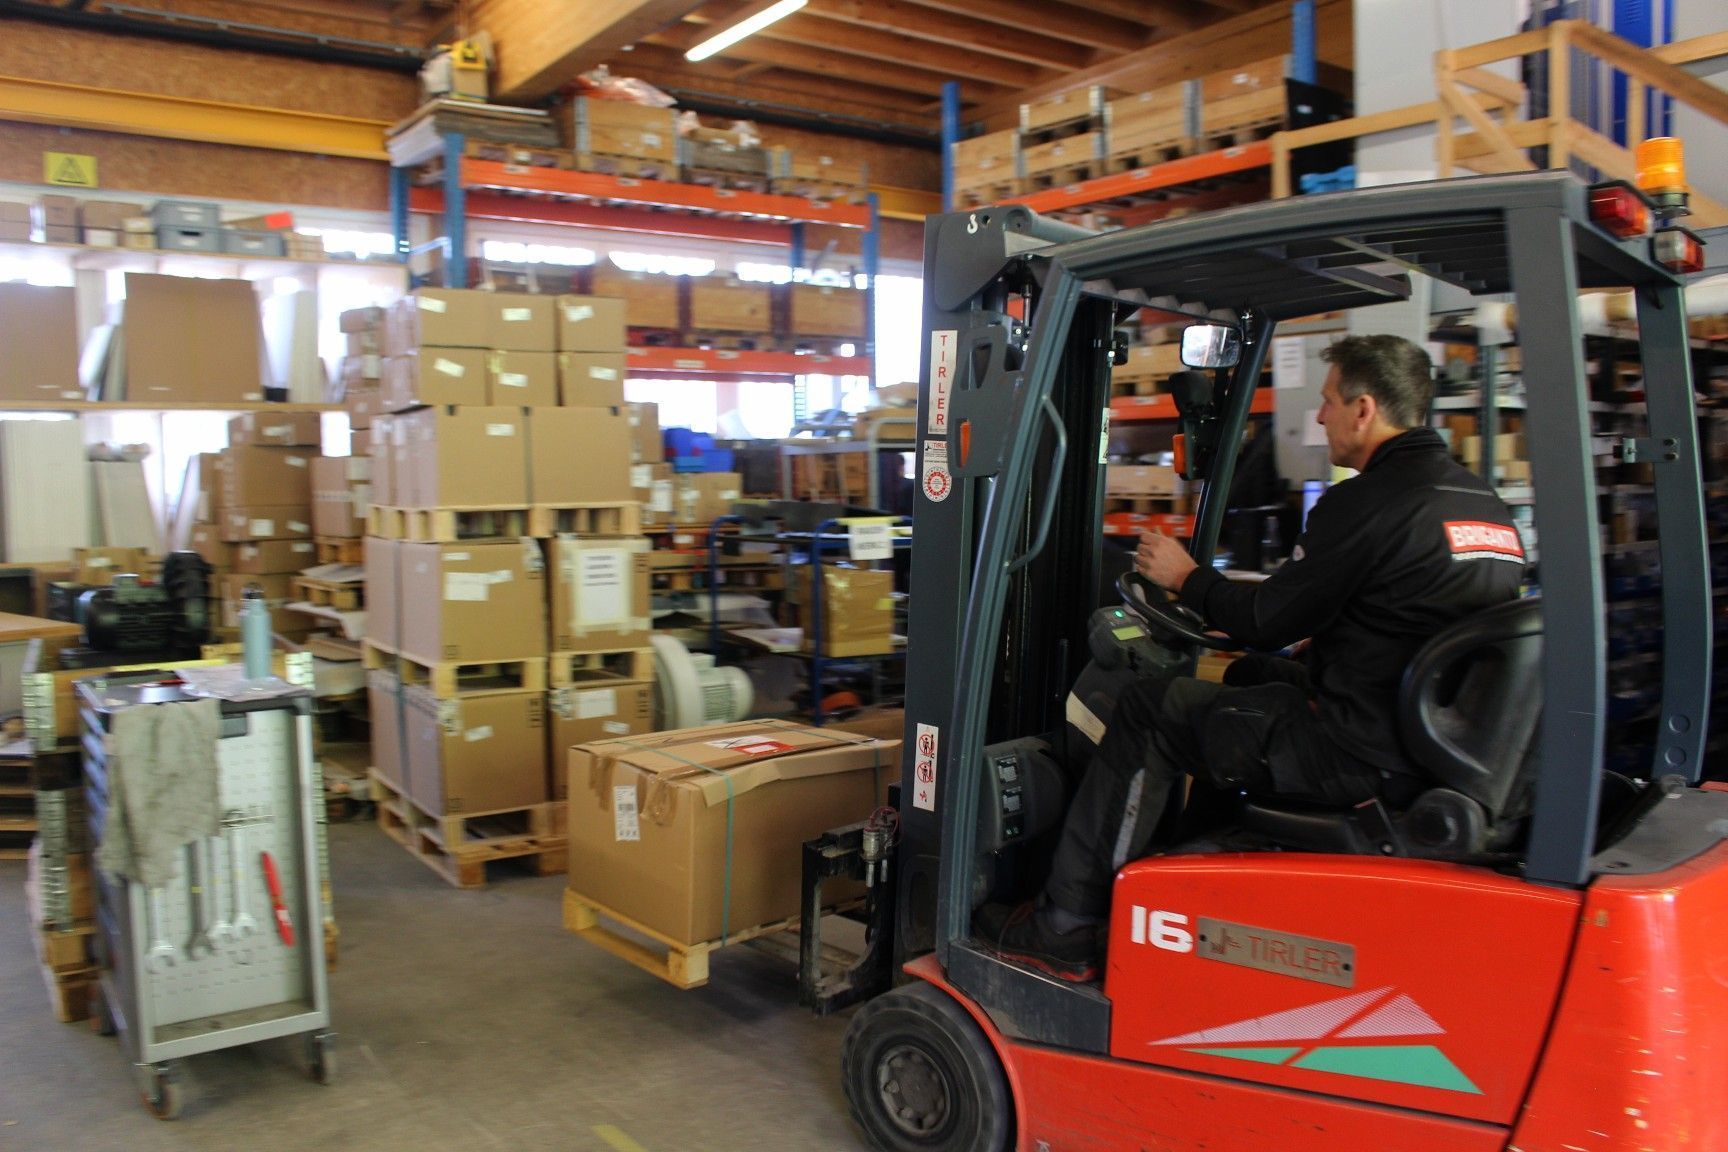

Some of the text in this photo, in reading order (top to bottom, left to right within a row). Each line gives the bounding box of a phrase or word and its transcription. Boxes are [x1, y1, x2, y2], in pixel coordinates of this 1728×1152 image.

[936, 335, 947, 425] TIRLER
[1131, 905, 1193, 953] 16
[1247, 935, 1342, 977] TIRLER
